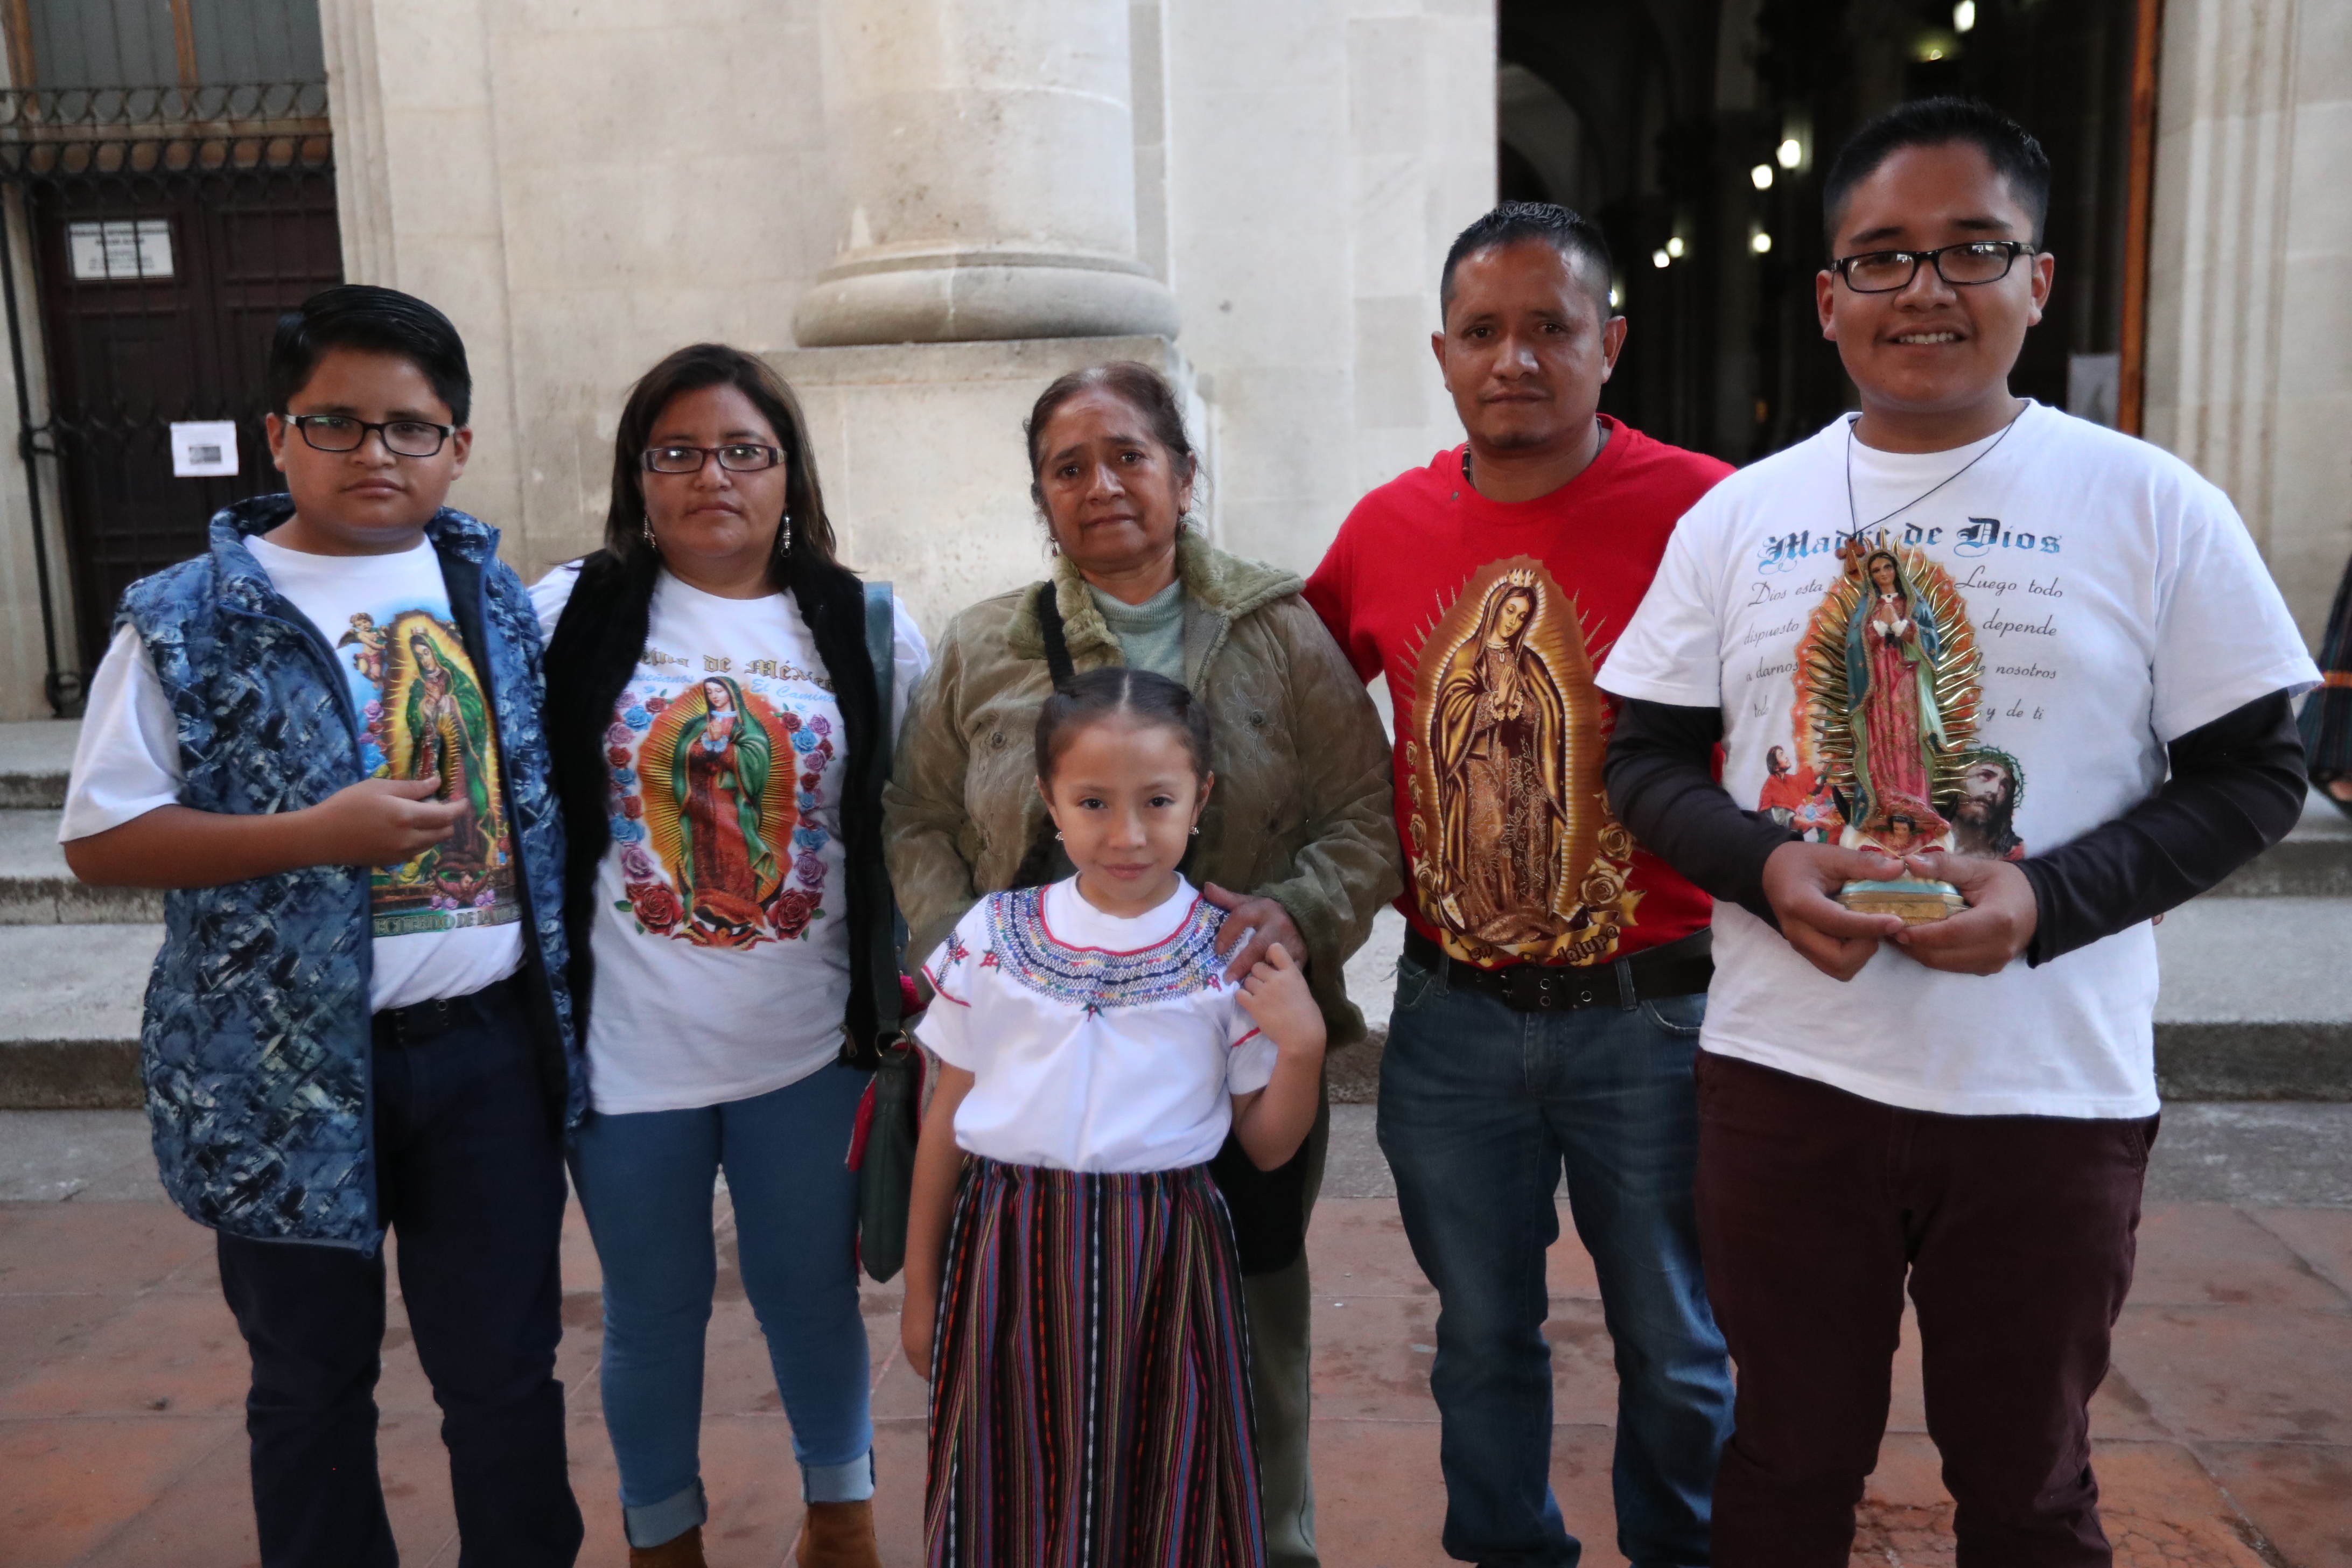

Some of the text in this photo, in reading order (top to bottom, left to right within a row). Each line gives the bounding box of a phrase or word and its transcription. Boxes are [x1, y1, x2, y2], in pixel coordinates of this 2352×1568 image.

[1757, 516, 2062, 575] Madre de Dios
[1748, 579, 1823, 606] Dios esta
[1954, 565, 2063, 598] Luego todo
[1744, 618, 1799, 648] dispuesto
[1983, 608, 2057, 638] depende
[638, 648, 690, 668] eina
[703, 655, 731, 673] de
[1756, 656, 1799, 678] darnos
[1996, 663, 2056, 678] nosotros
[751, 678, 836, 703] El Camino
[1986, 699, 2044, 722] y de ti
[374, 914, 455, 934] ECUERDO
